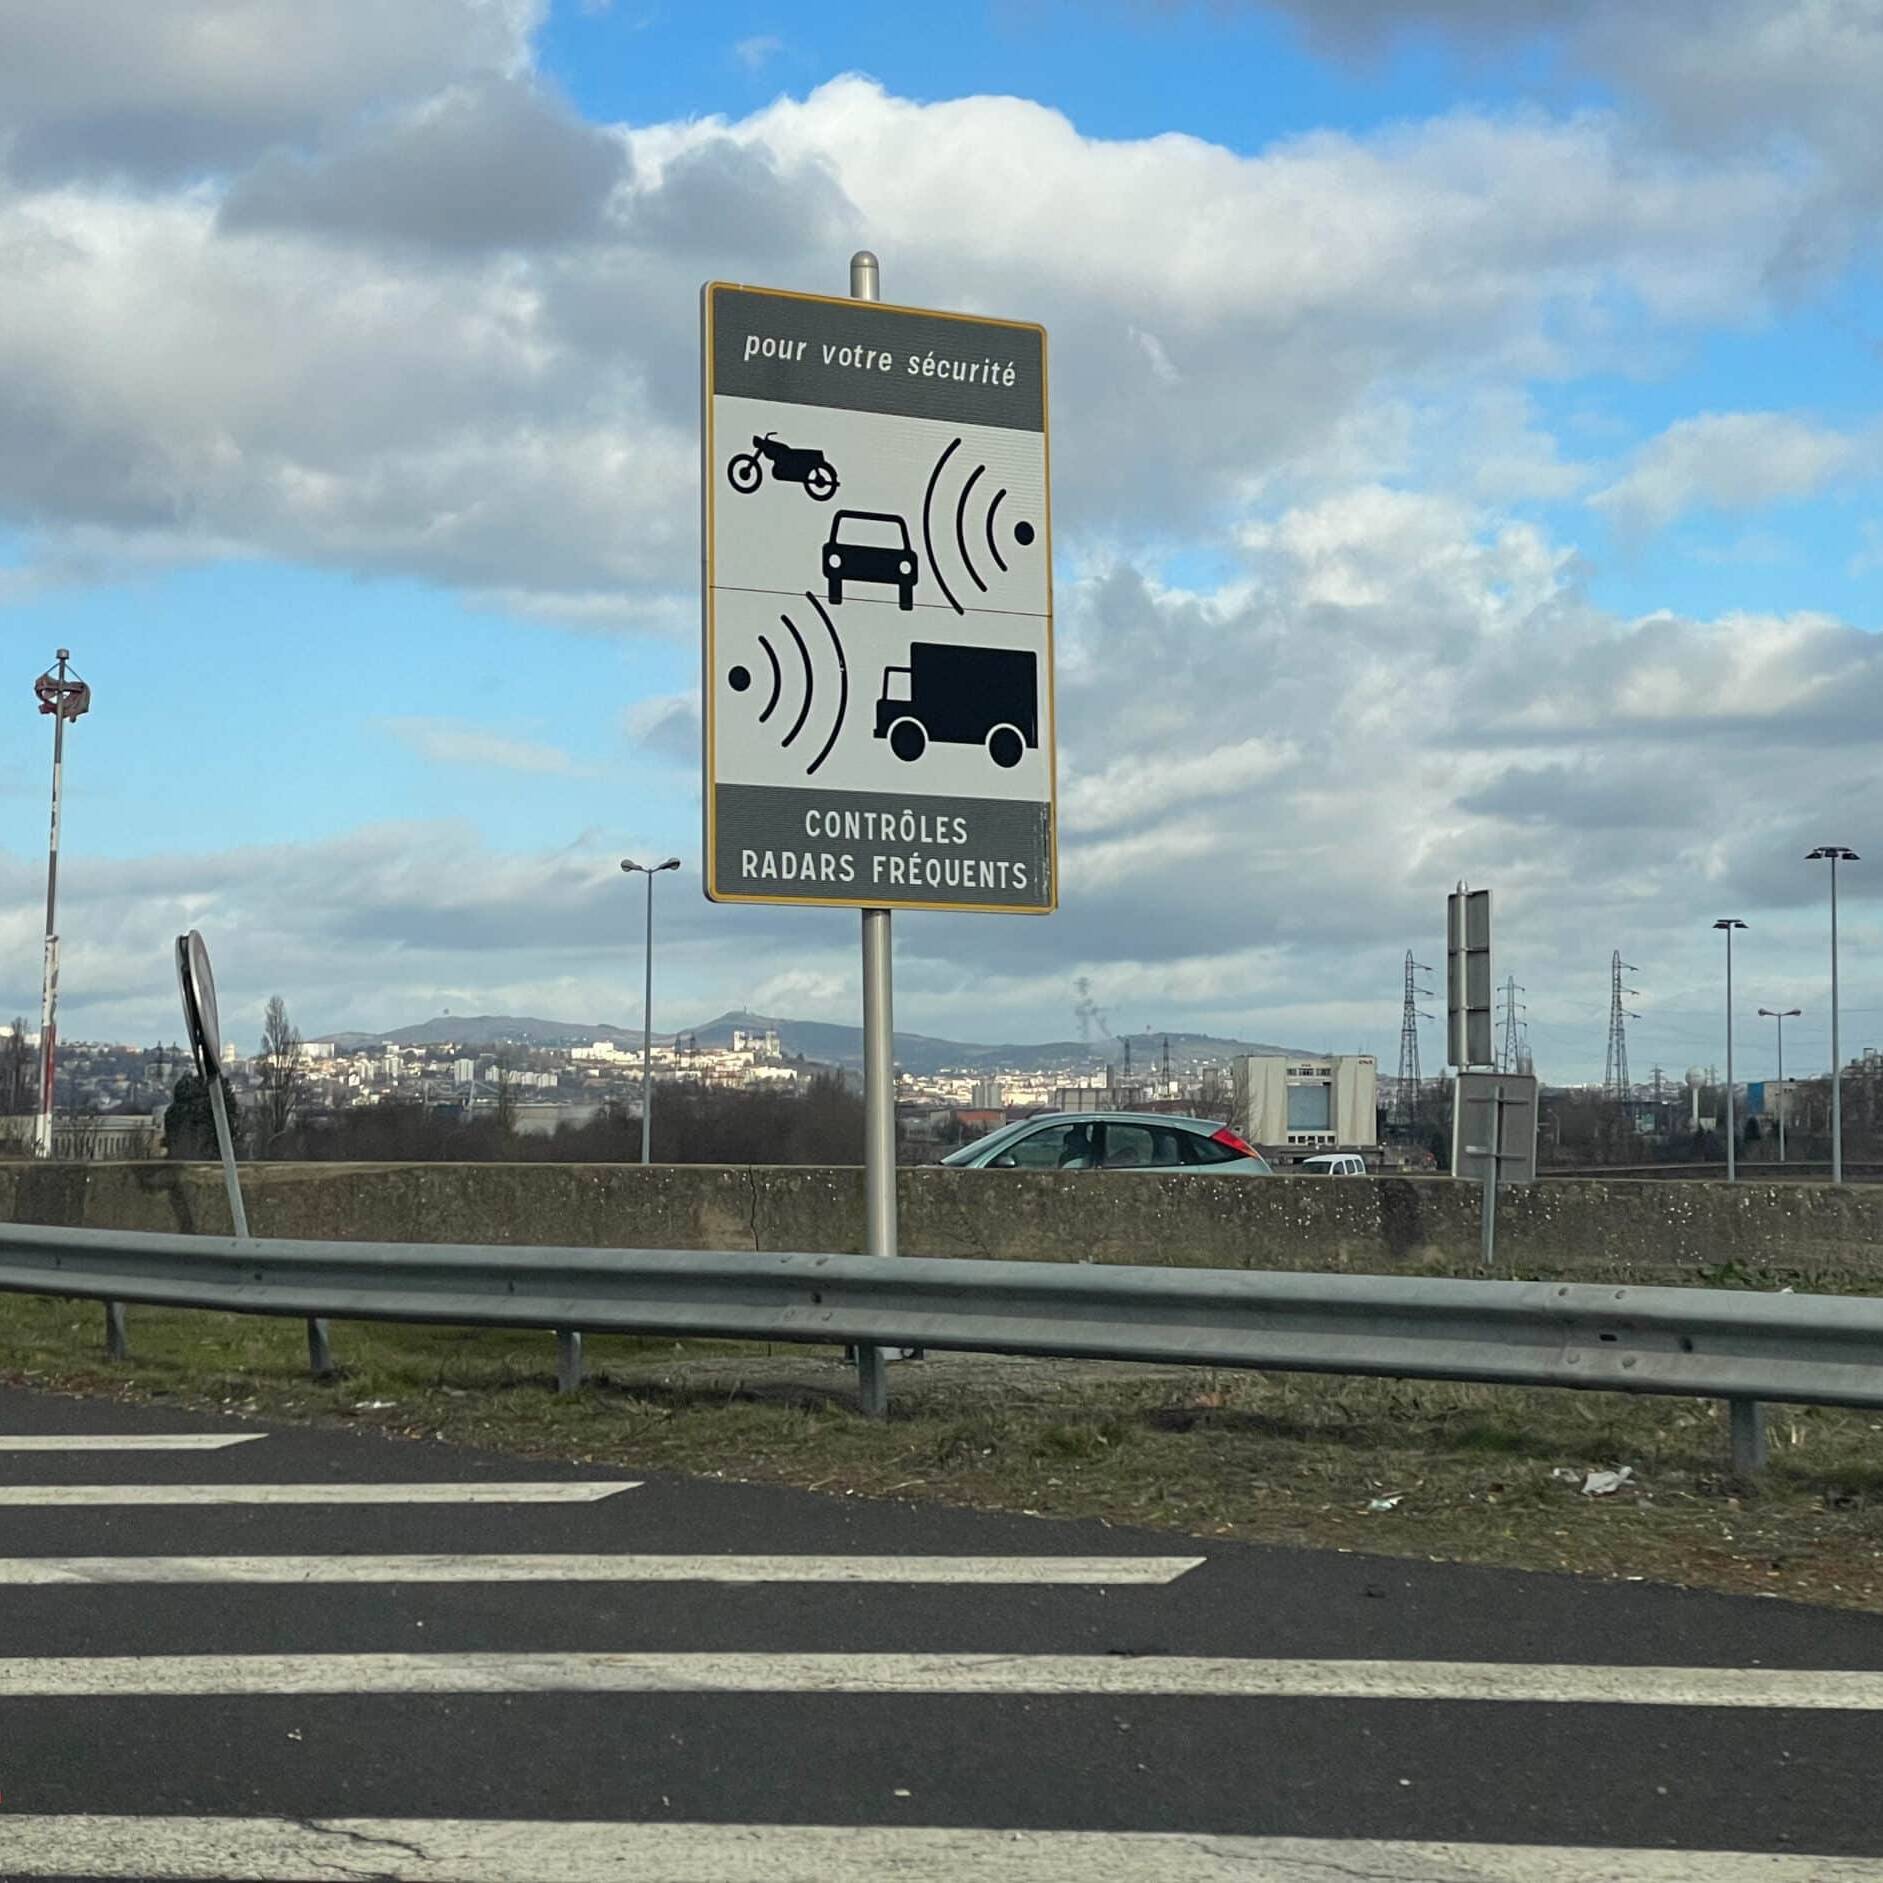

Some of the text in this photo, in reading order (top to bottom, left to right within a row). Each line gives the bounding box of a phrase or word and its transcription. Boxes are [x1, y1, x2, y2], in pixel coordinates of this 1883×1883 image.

[743, 334, 1017, 387] pour votre sécurité
[805, 808, 968, 845] CONTRÔLES
[741, 849, 1028, 889] RADARS FRÉQUENTS
